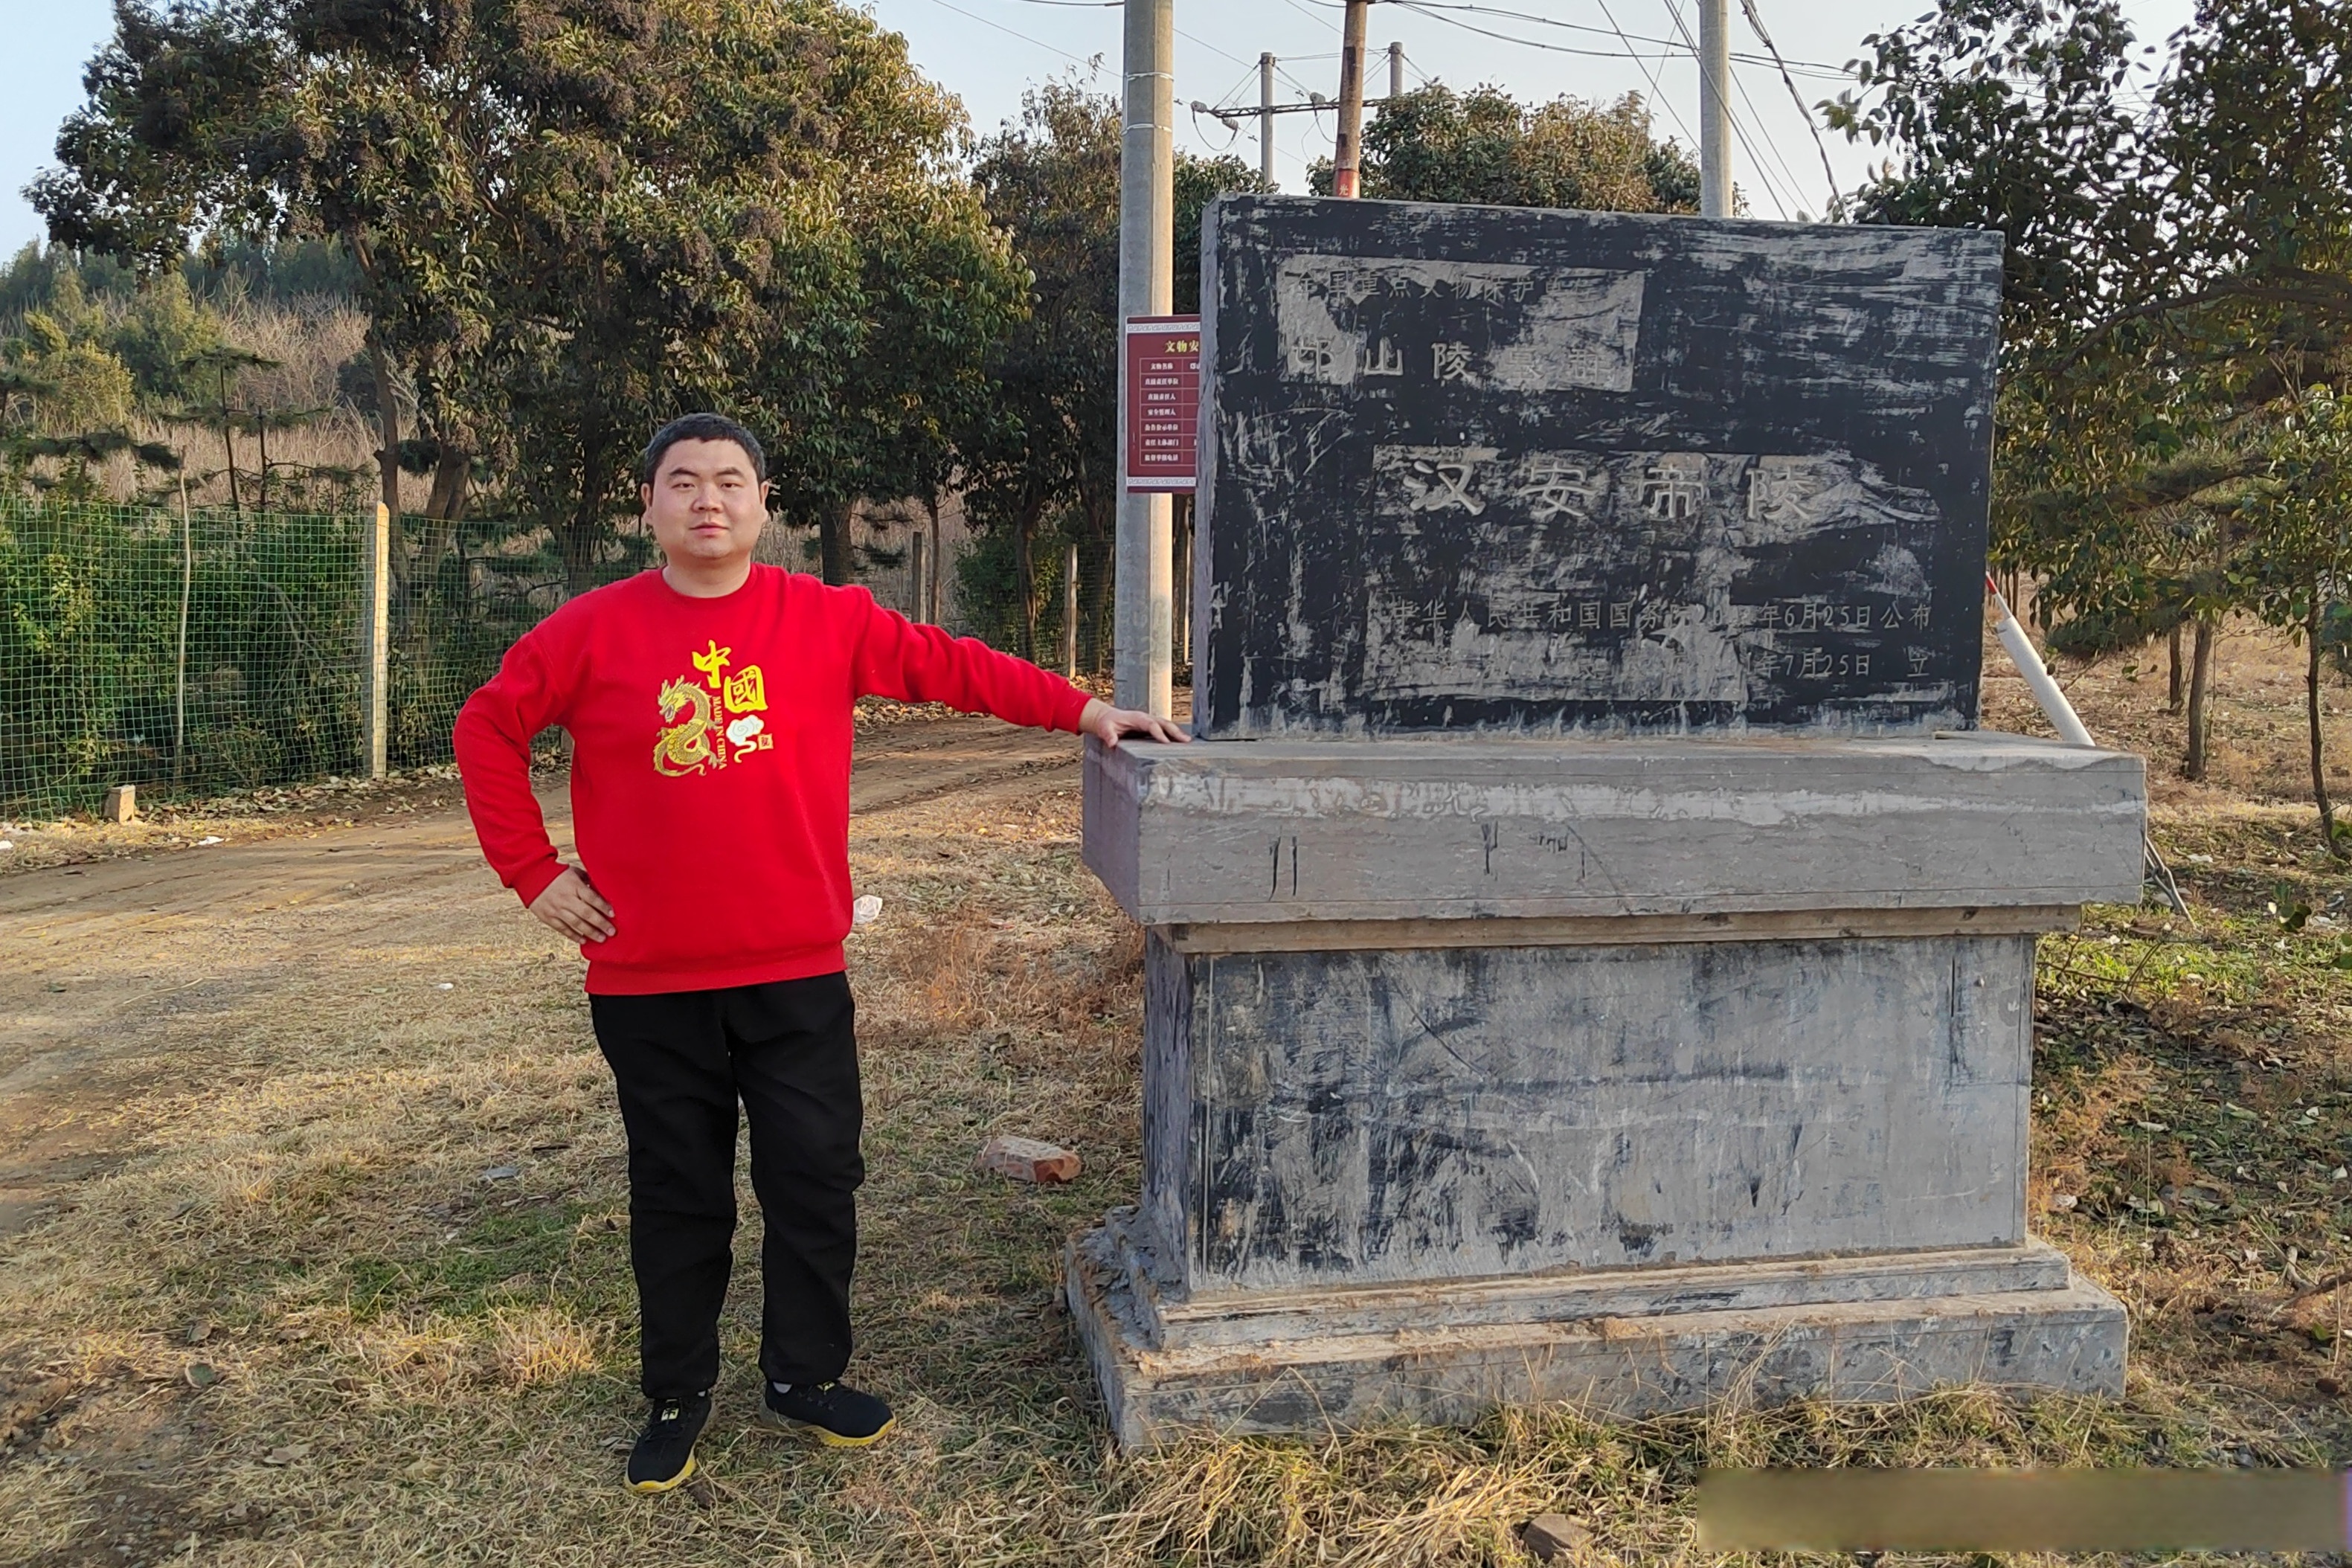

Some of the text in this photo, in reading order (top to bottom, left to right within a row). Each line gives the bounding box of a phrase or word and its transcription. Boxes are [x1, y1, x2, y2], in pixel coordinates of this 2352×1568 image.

[1404, 462, 1819, 519] 汉安帝陵
[713, 695, 723, 724] MADE
[716, 737, 727, 770] CHINA
